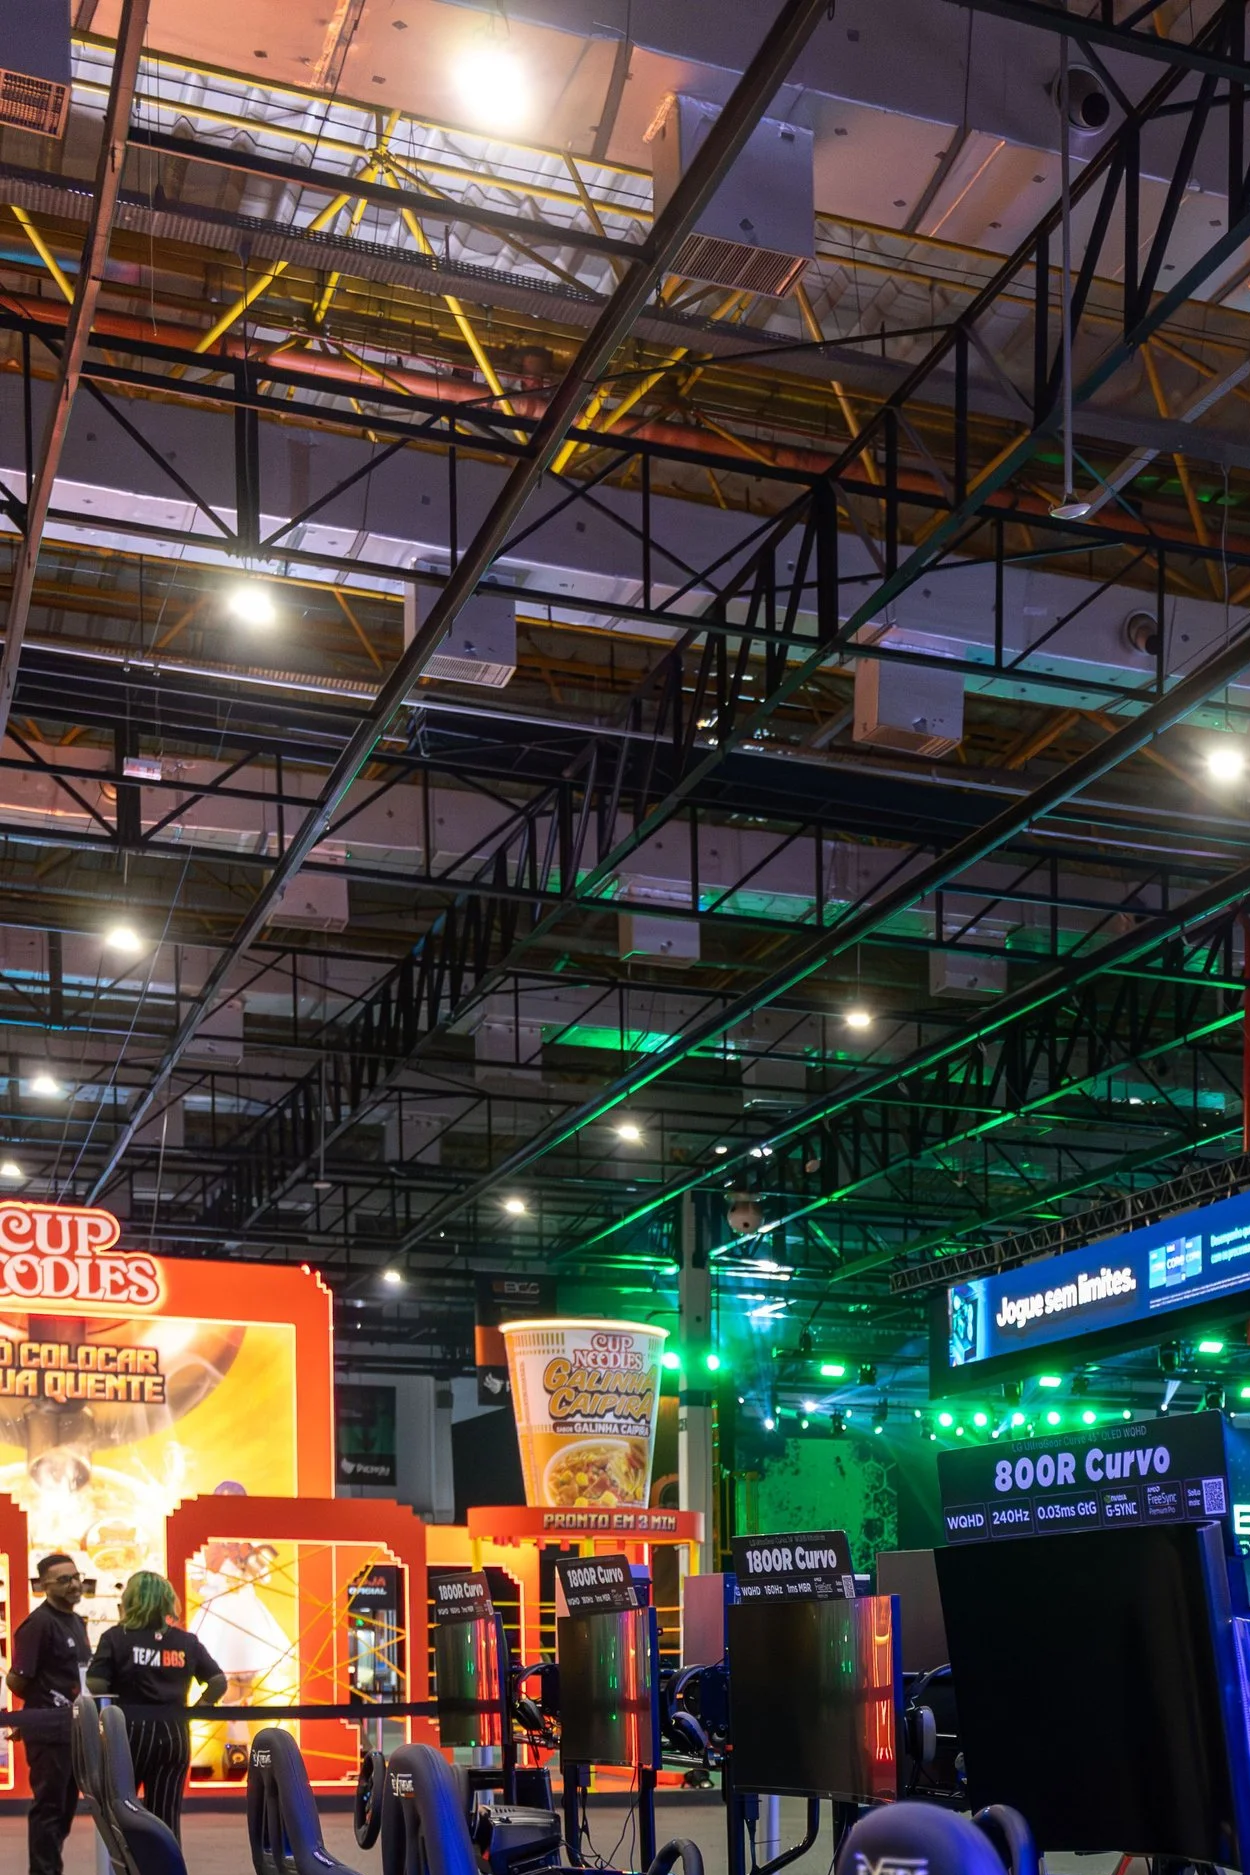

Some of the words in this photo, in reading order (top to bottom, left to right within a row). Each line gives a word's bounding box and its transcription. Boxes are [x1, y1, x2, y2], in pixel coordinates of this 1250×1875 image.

[0, 1209, 113, 1256] CUP
[0, 1253, 159, 1305] ODLES
[996, 1294, 1044, 1329] Jogue
[1045, 1283, 1077, 1315] sem
[1078, 1267, 1136, 1305] limites.
[592, 1333, 633, 1352] CUP
[19, 1341, 158, 1374] COLOCAR
[573, 1349, 643, 1371] NOODLES
[44, 1370, 165, 1403] QUENTE
[574, 1422, 620, 1435] GALINHA
[1123, 1425, 1147, 1438] WQHD
[995, 1452, 1076, 1492] 800R
[1085, 1446, 1170, 1482] Curvo
[992, 1509, 1030, 1525] 240Hz
[1037, 1504, 1076, 1520] 0.03ms
[1077, 1500, 1097, 1516] GtG
[1105, 1502, 1138, 1517] G-SYNC
[543, 1513, 609, 1529] PRONTO
[613, 1514, 634, 1529] EM
[638, 1515, 648, 1529] 3
[651, 1515, 676, 1530] MIN
[947, 1513, 985, 1530] WQHD
[746, 1547, 793, 1573] 1800R
[795, 1546, 837, 1570] Curvo
[567, 1569, 598, 1588] 1800R
[597, 1566, 624, 1585] Curvo
[438, 1584, 464, 1600] 1800R
[741, 1586, 761, 1596] WQHD
[163, 1649, 186, 1669] BGS
